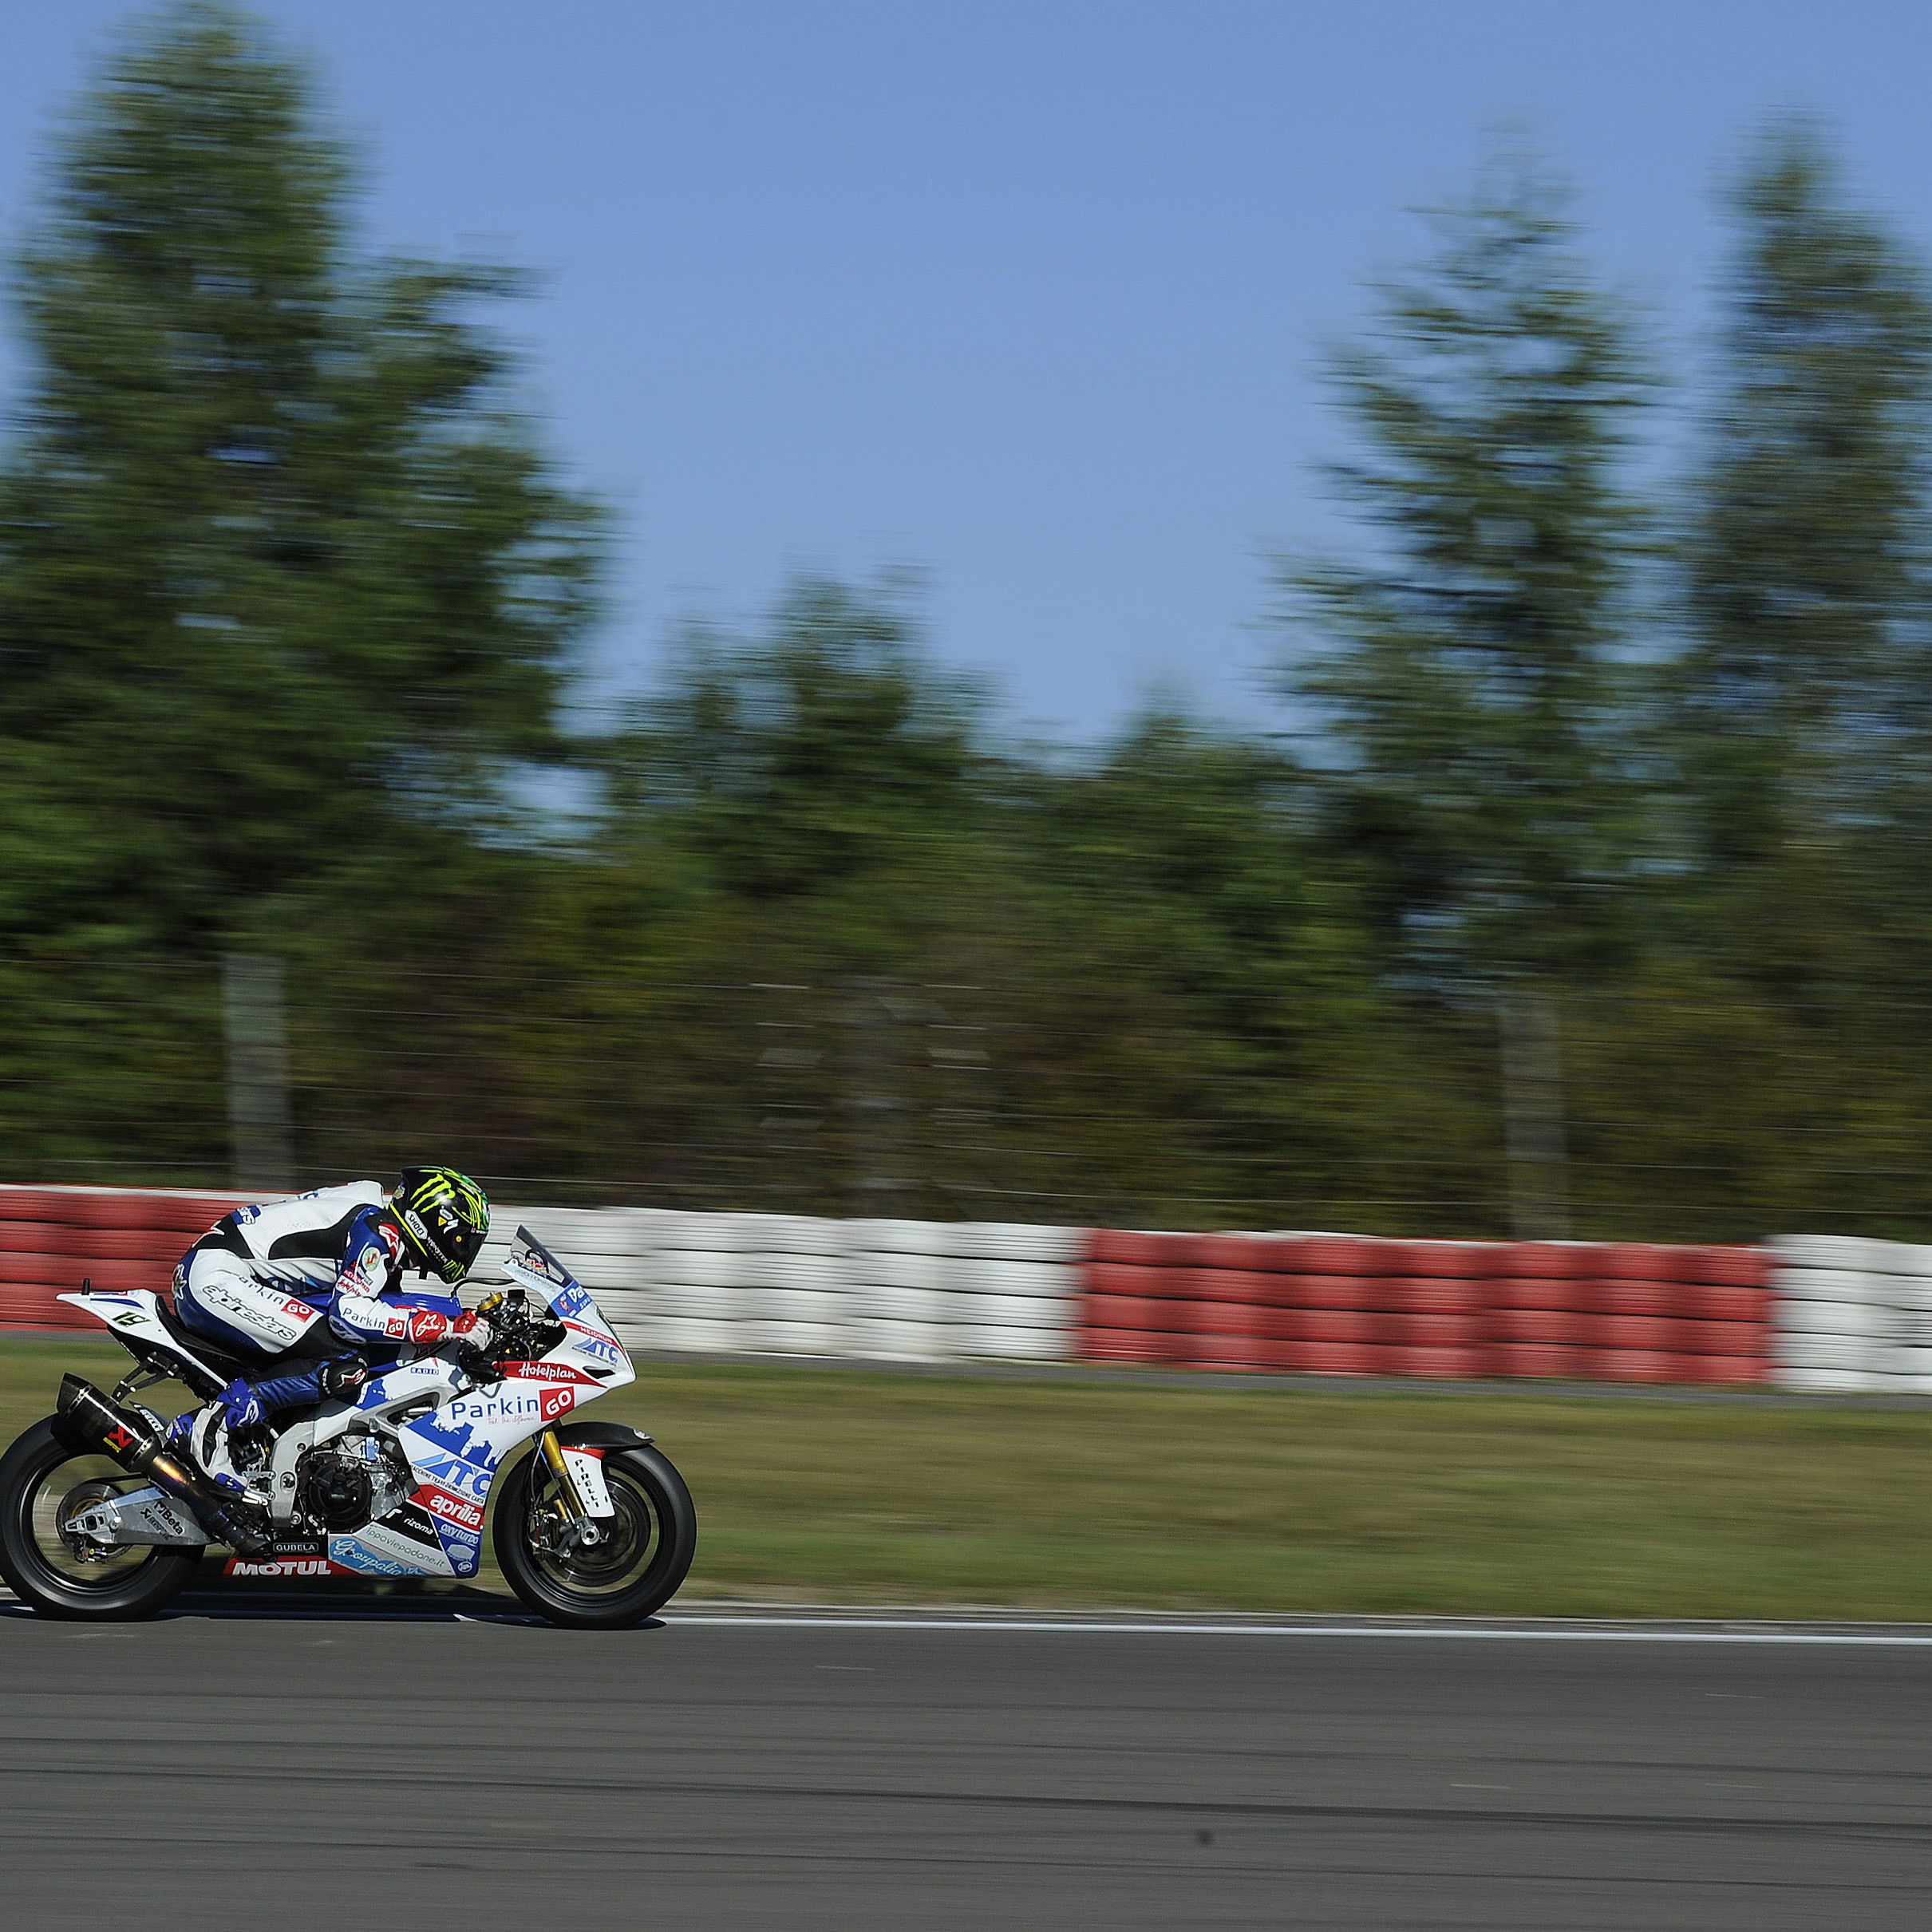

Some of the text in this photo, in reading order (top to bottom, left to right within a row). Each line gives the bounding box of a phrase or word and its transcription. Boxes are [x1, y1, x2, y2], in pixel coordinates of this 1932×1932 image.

[407, 1213, 425, 1236] SHOEI
[203, 1285, 298, 1341] alpinestars
[342, 1307, 404, 1334] Parkin GO
[519, 1361, 578, 1380] Hotelplan
[451, 1389, 573, 1420] Parkin GO
[163, 1507, 184, 1536] Beta
[429, 1493, 481, 1527] aprilia
[403, 1517, 433, 1535] rizoma
[231, 1560, 332, 1576] MOTUL
